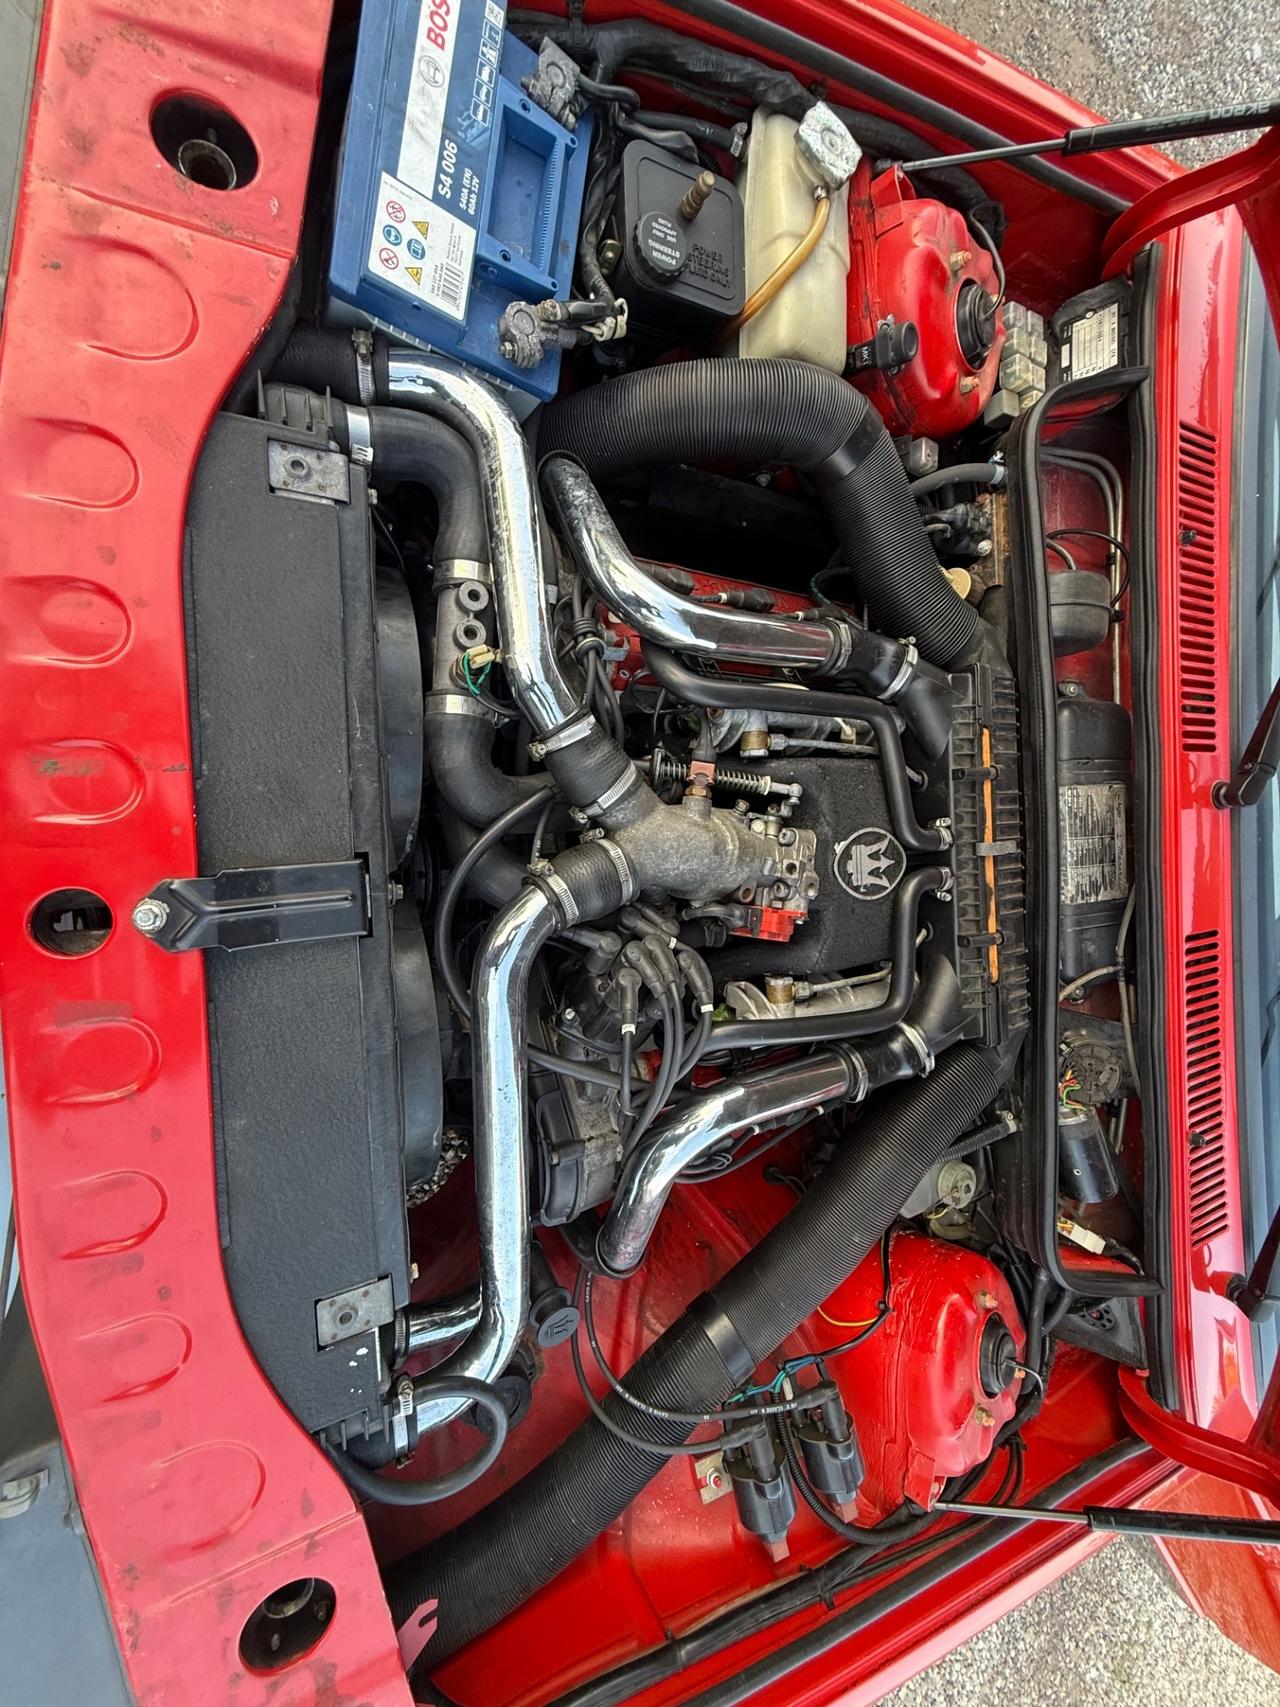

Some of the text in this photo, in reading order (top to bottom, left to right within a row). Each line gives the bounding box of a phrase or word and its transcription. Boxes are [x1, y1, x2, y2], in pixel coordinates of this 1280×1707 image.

[438, 139, 458, 199] S4 006
[459, 168, 472, 210] 540A (EN)
[468, 175, 480, 215] 60Ah 12V
[648, 239, 680, 258] STEERING
[652, 250, 677, 266] POWER
[692, 243, 722, 261] POWER
